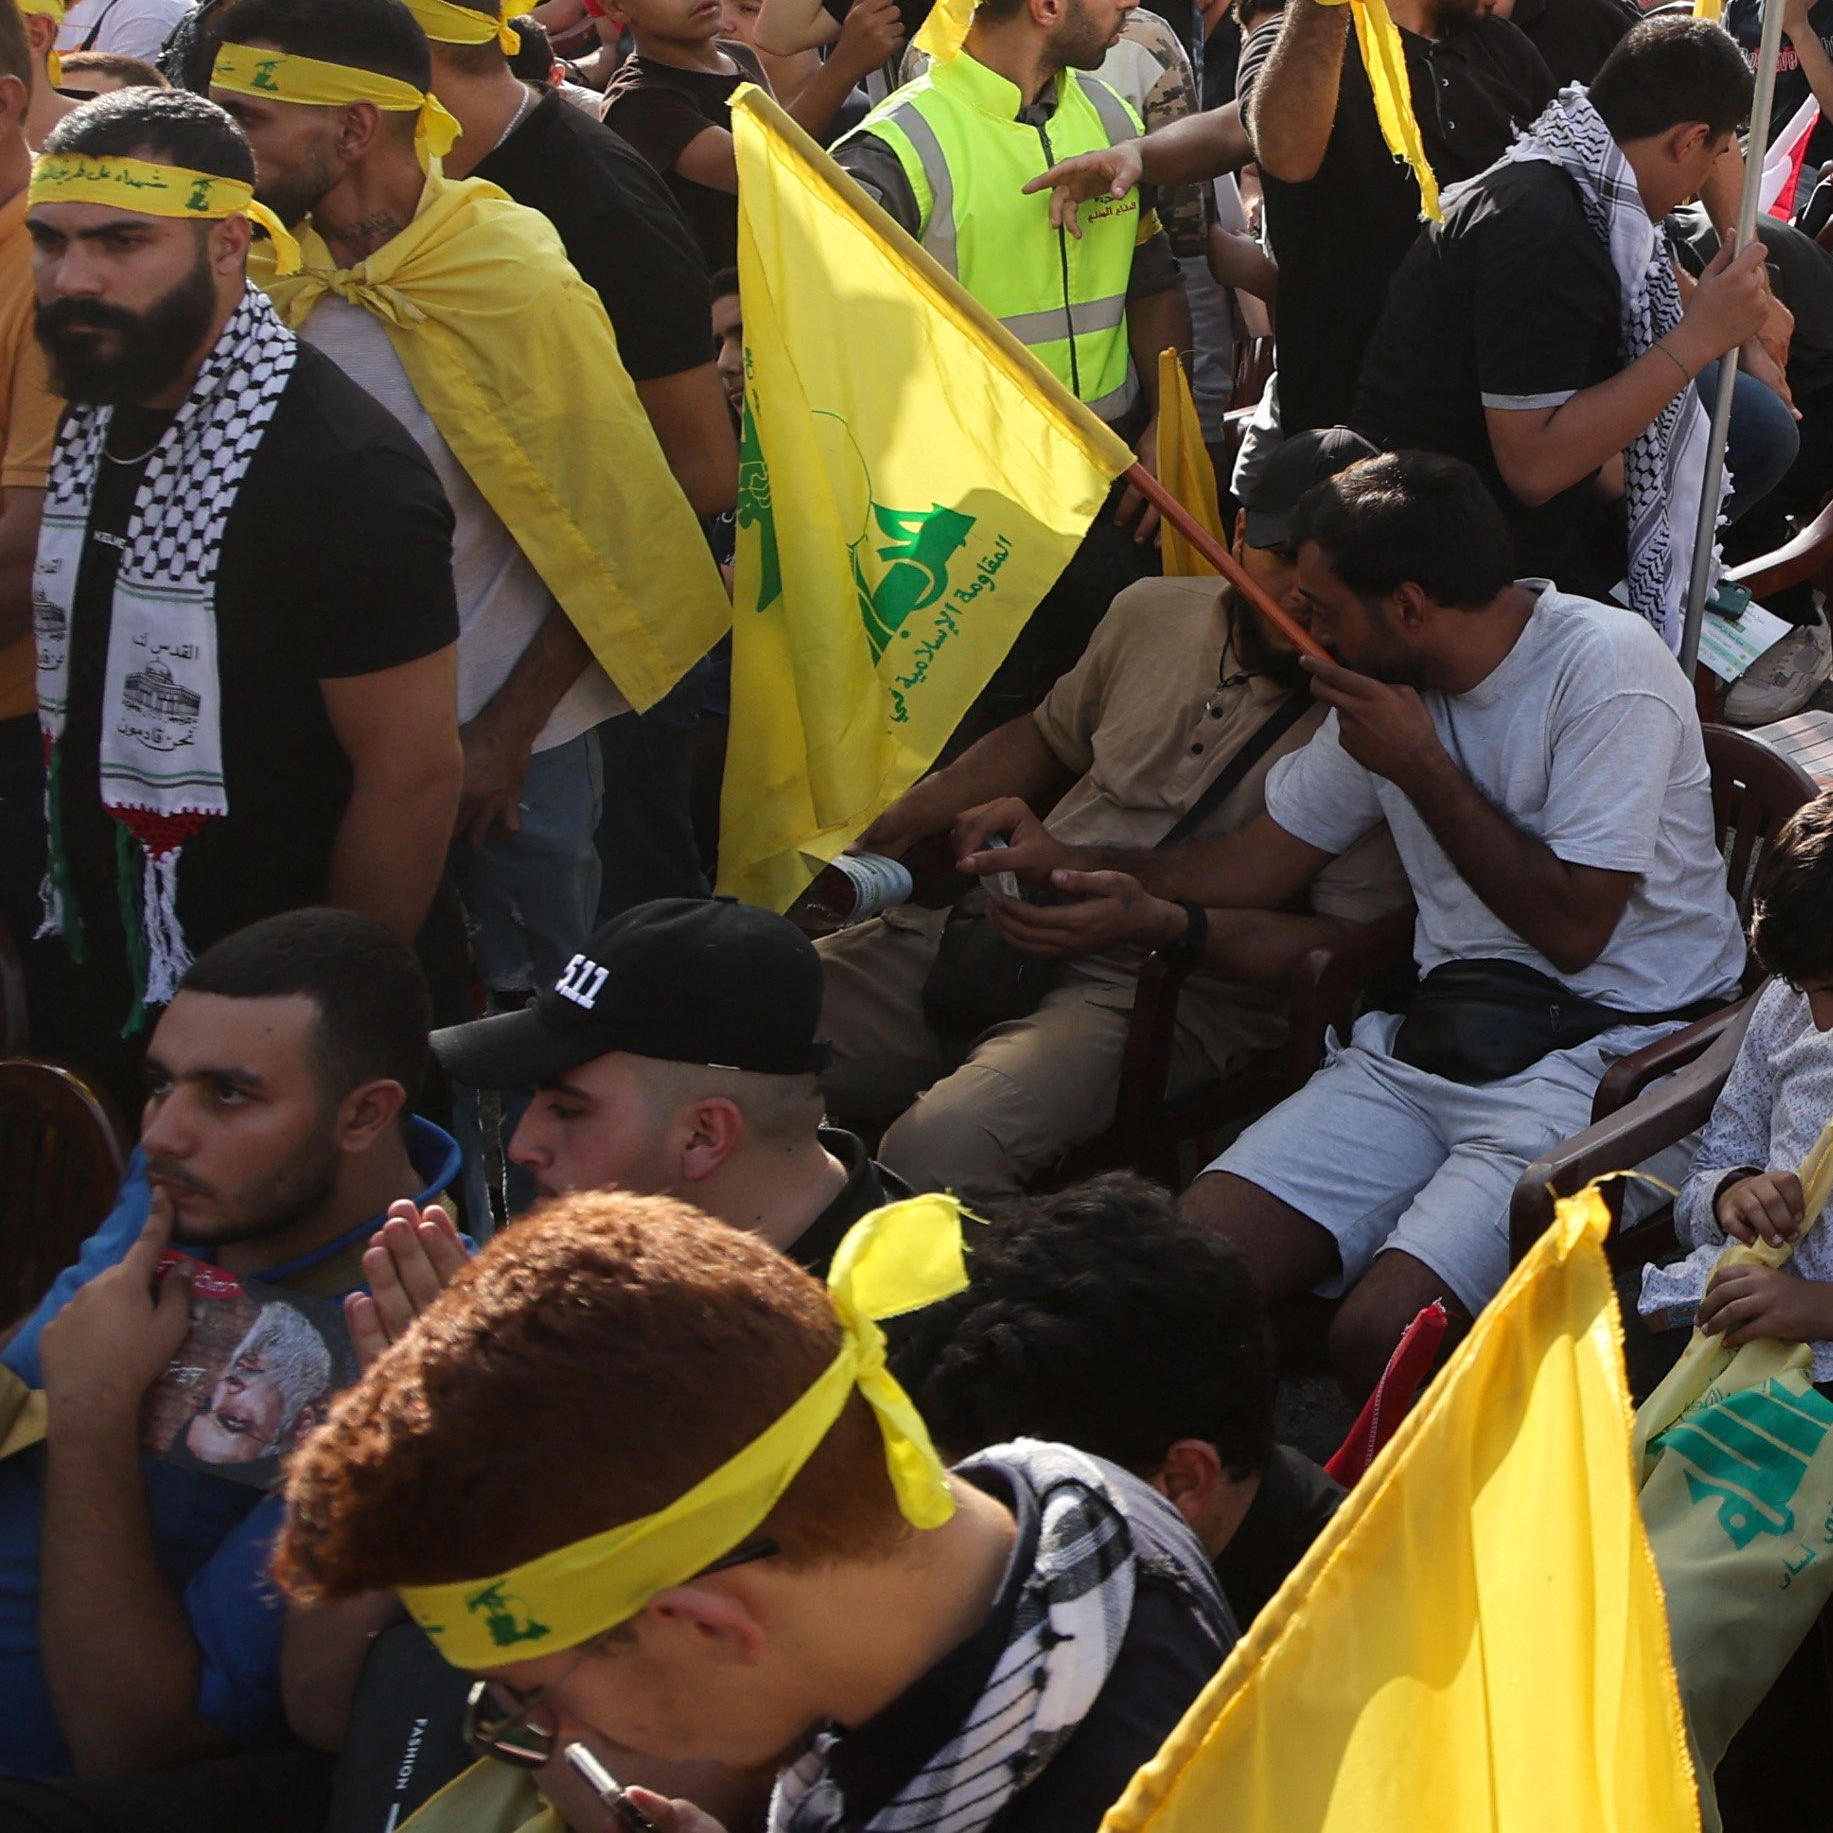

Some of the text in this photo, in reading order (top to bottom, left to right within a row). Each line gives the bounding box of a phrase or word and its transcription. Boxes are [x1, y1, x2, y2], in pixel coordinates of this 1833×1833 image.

[962, 534, 1014, 604] المقاومة
[906, 602, 963, 690] الإسلامية
[395, 1718, 429, 1790] FASHION
